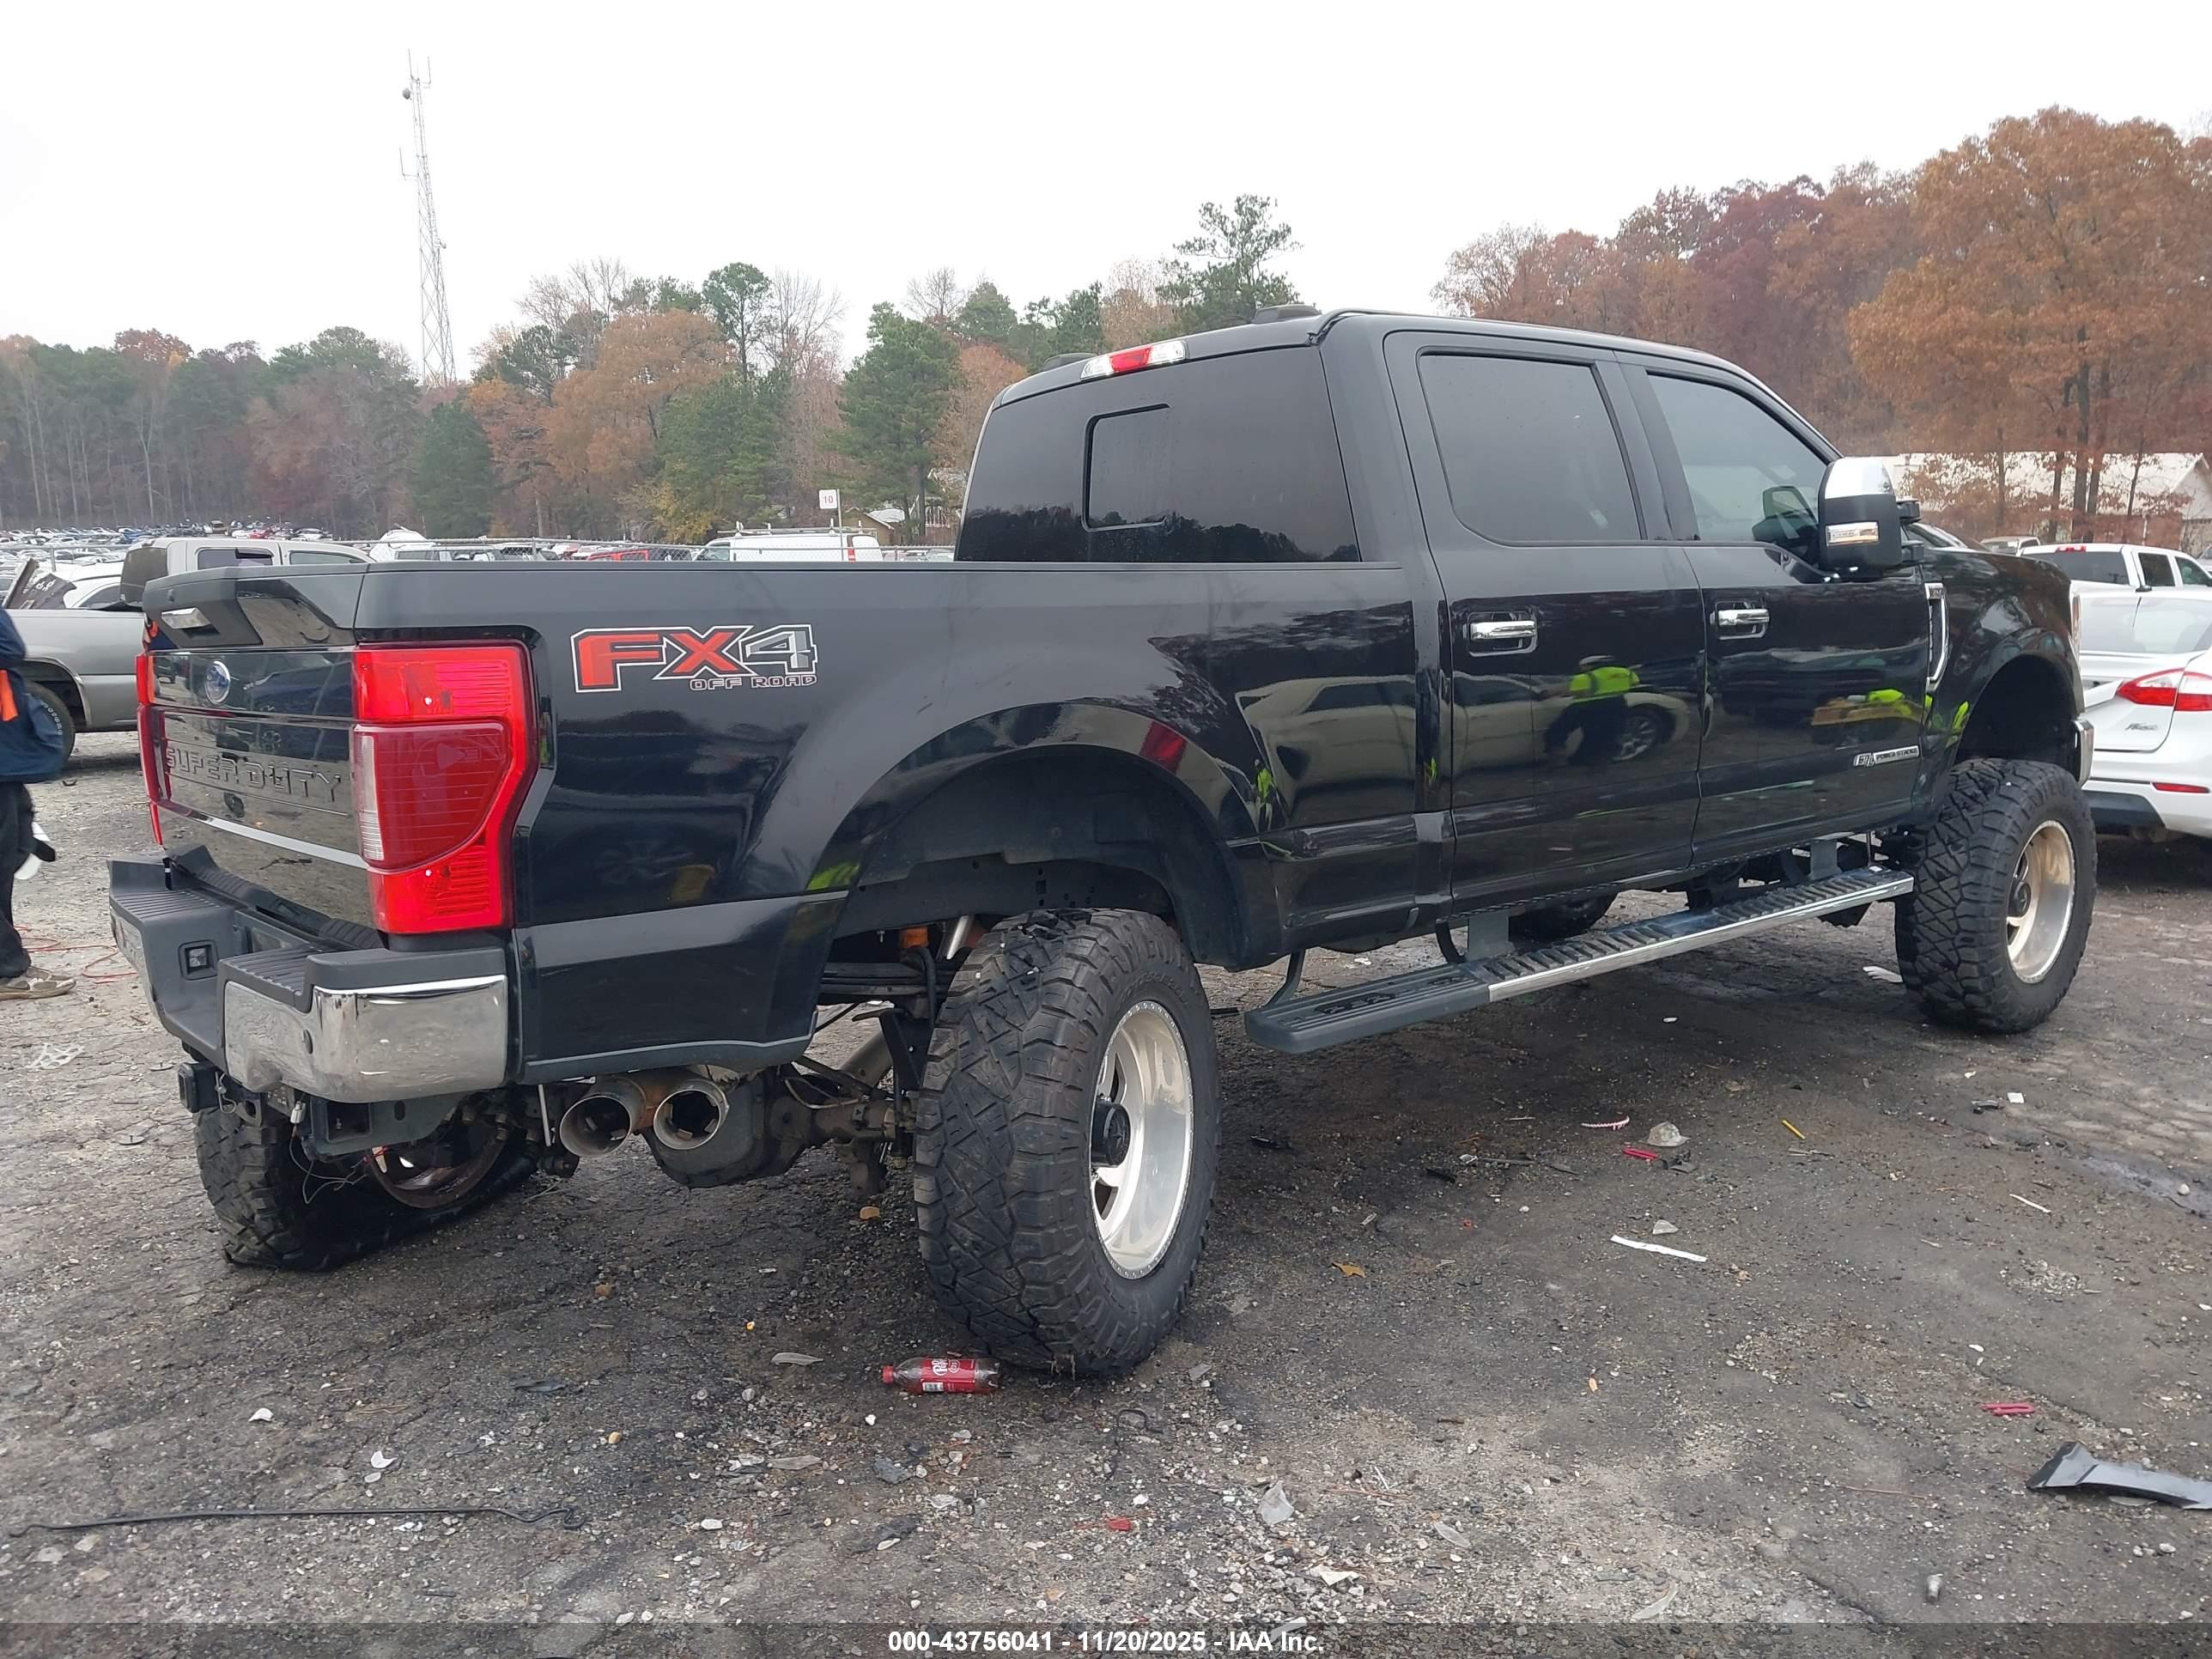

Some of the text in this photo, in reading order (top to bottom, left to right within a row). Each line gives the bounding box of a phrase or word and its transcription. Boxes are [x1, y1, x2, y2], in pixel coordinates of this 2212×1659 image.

[570, 623, 818, 694] FX4
[690, 674, 817, 691] OFF ROAD
[166, 747, 340, 802] SUPER DUTY
